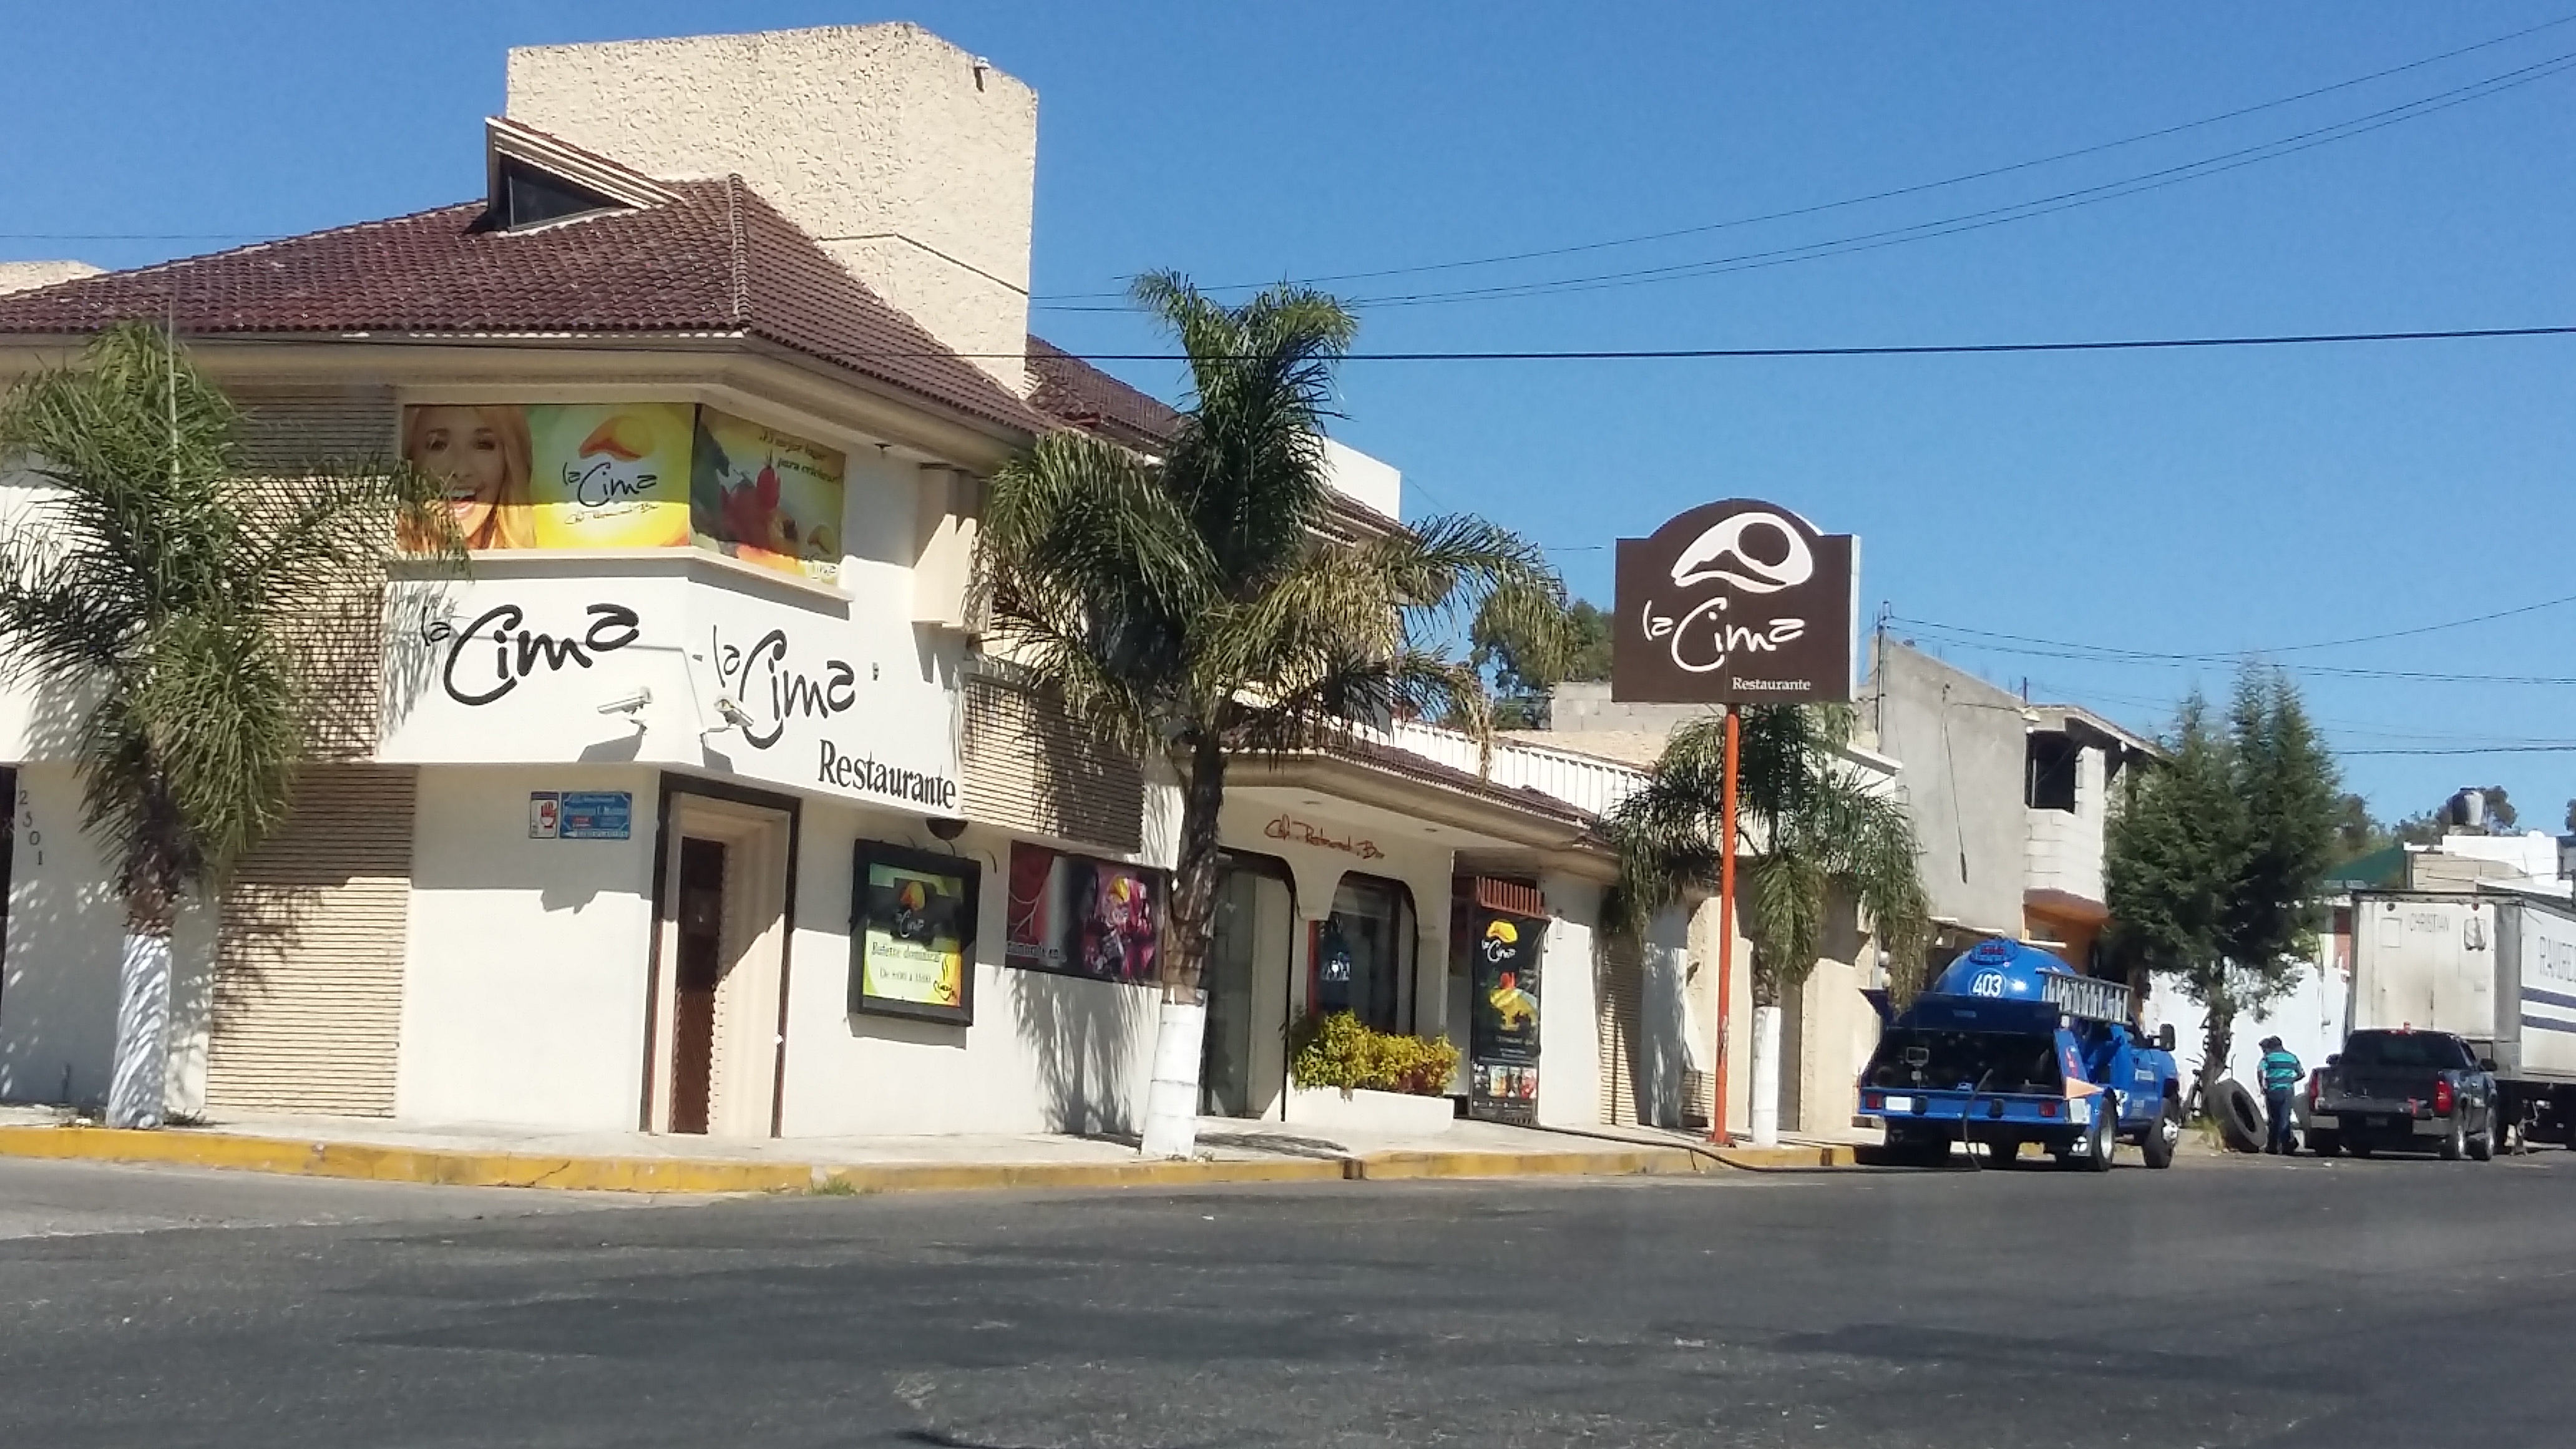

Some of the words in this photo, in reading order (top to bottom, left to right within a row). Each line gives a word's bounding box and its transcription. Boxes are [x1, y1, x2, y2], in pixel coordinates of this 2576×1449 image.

[562, 462, 581, 485] la
[578, 462, 658, 507] Cima
[421, 607, 451, 646] la
[444, 603, 640, 706] Cima
[1642, 600, 1674, 641] la
[1671, 597, 1805, 672] Cima
[713, 624, 741, 688] la
[739, 628, 856, 749] Cima
[1732, 677, 1811, 691] Restaurante
[818, 738, 957, 809] Restaurante
[1487, 940, 1516, 962] Cima
[1972, 973, 2002, 998] 403
